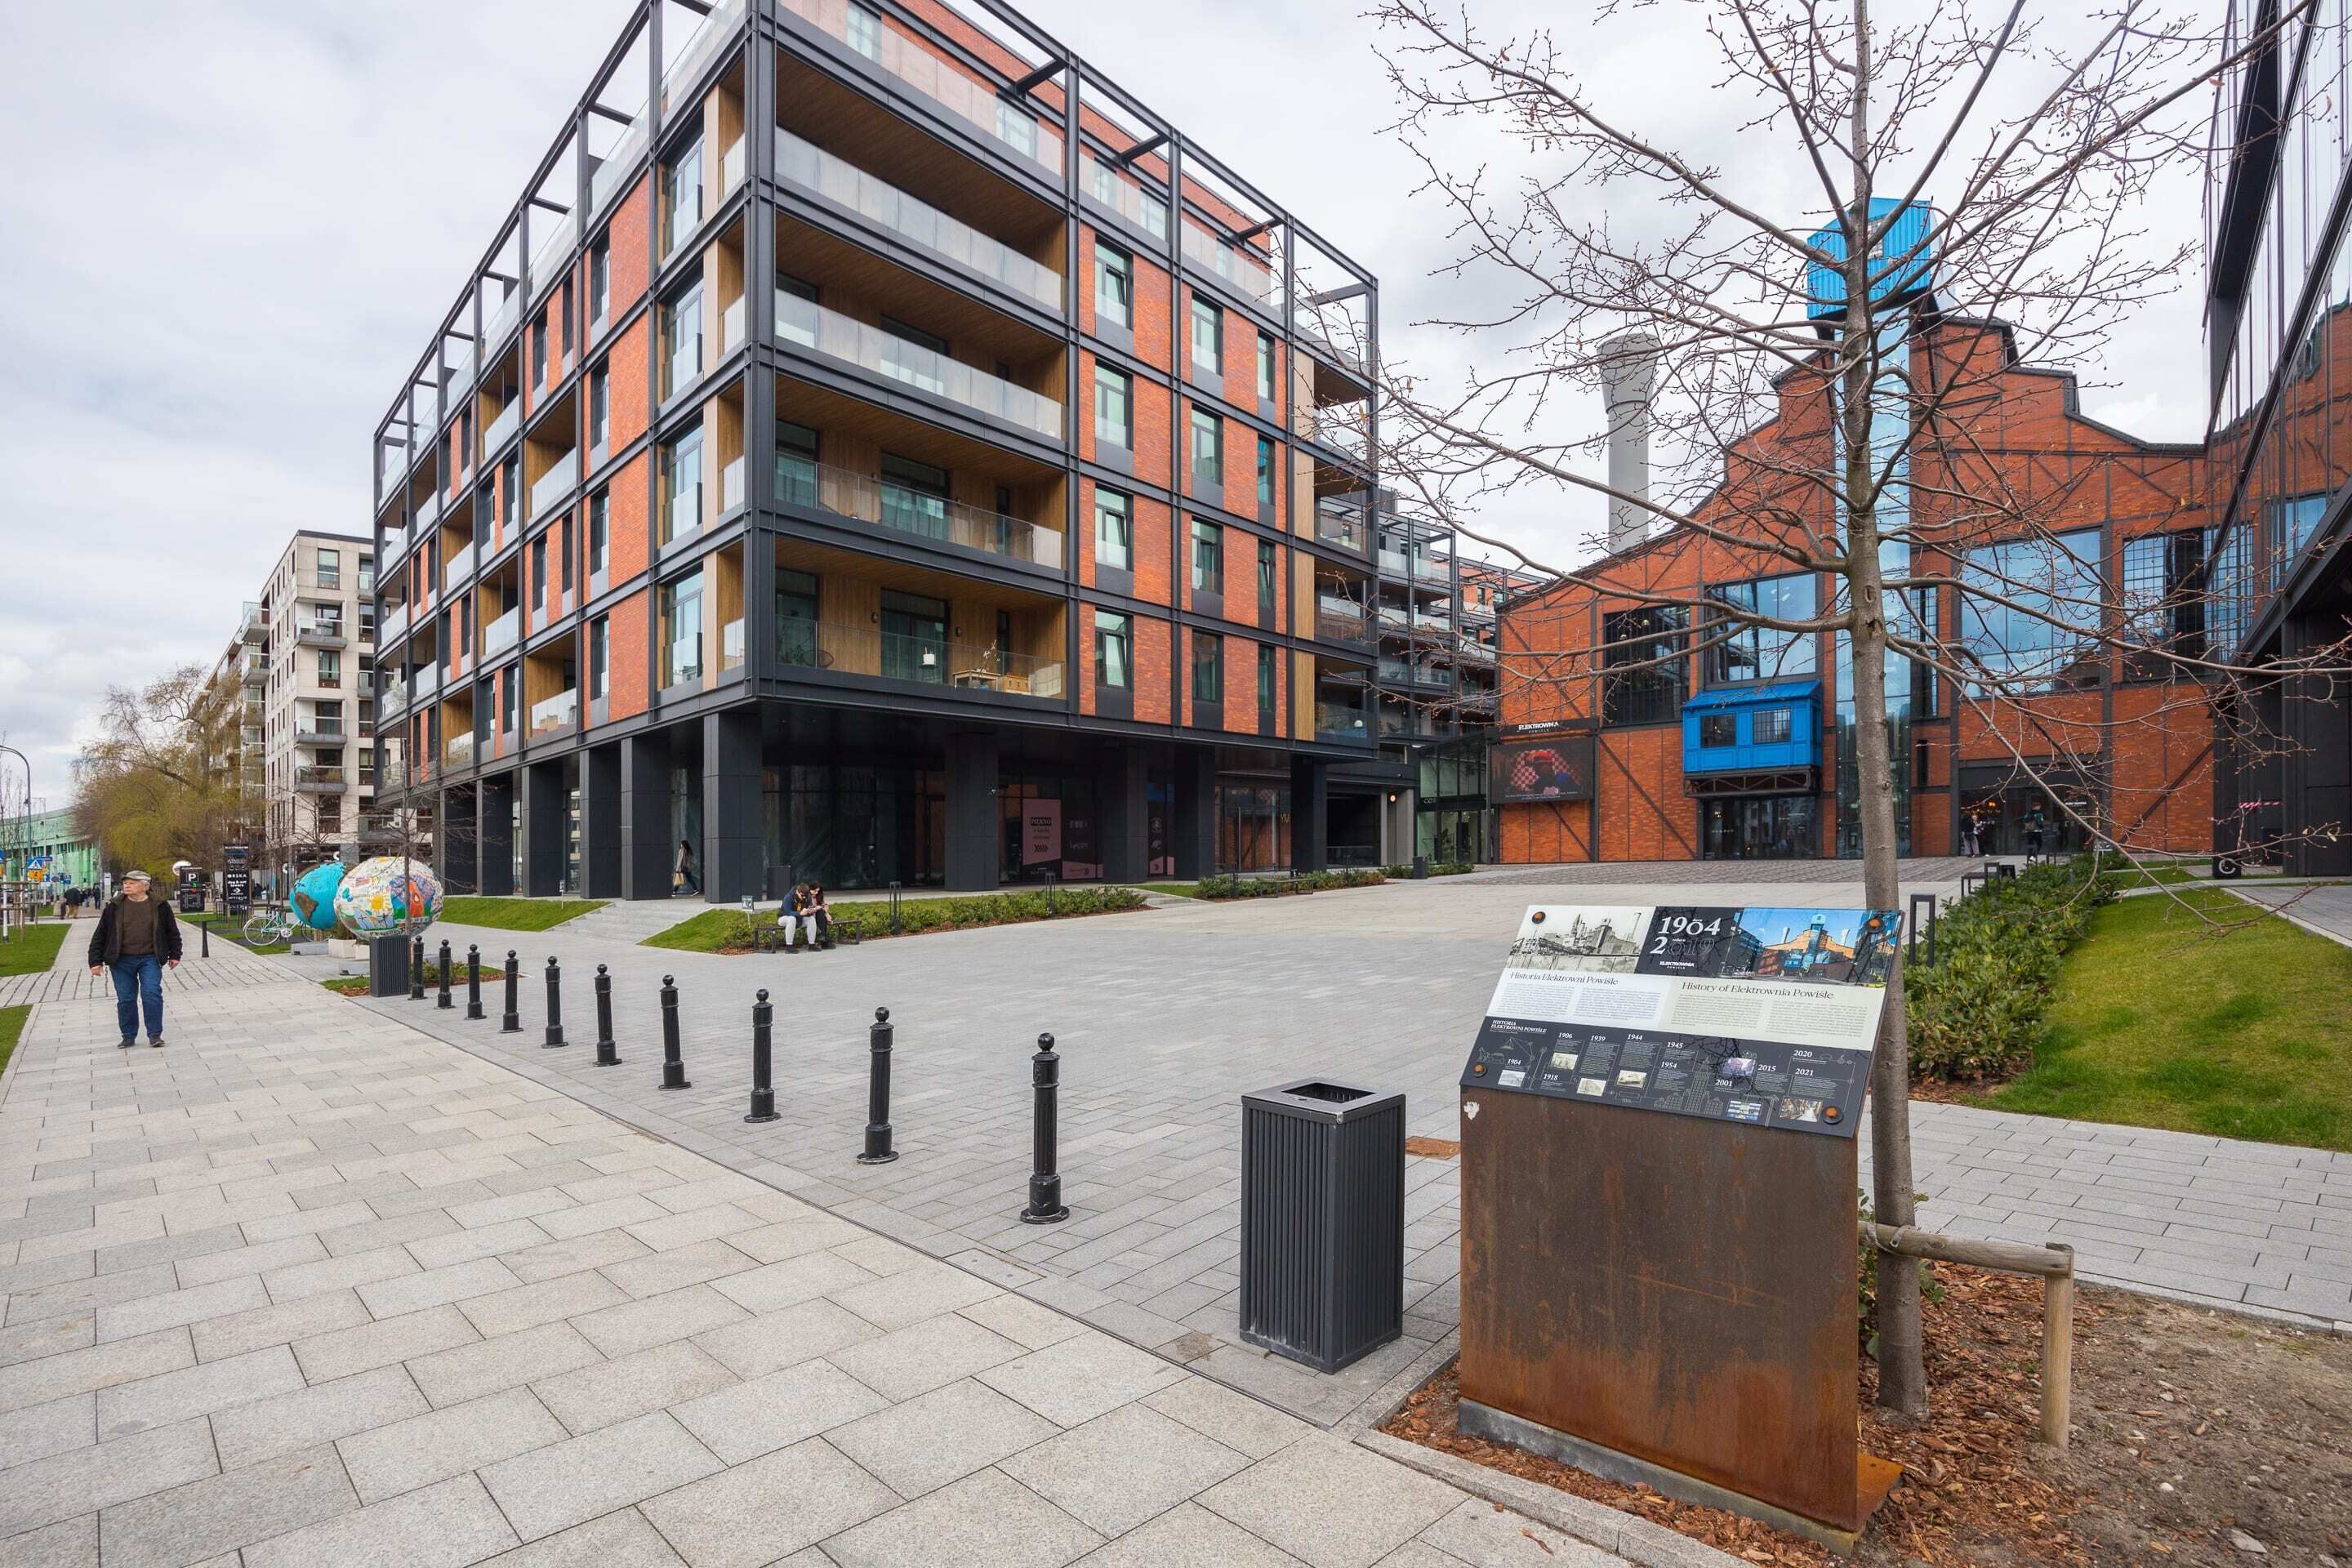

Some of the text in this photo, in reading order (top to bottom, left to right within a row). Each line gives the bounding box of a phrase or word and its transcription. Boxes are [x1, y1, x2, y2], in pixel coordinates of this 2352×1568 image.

[2218, 858, 2236, 874] C
[188, 873, 197, 882] P
[1658, 916, 1722, 936] 1904
[1650, 936, 1715, 956] 2019
[1510, 971, 1619, 986] Historia Elektrowni Powiśle
[1682, 982, 1835, 1000] History of Elektrownia Powiśle
[1490, 1023, 1524, 1031] ELEKTROWNI
[1793, 1049, 1813, 1058] 2020
[1661, 1061, 1677, 1069] 1954
[1757, 1064, 1777, 1072] 2015
[1794, 1068, 1814, 1076] 2021
[1715, 1079, 1733, 1087] 2001
